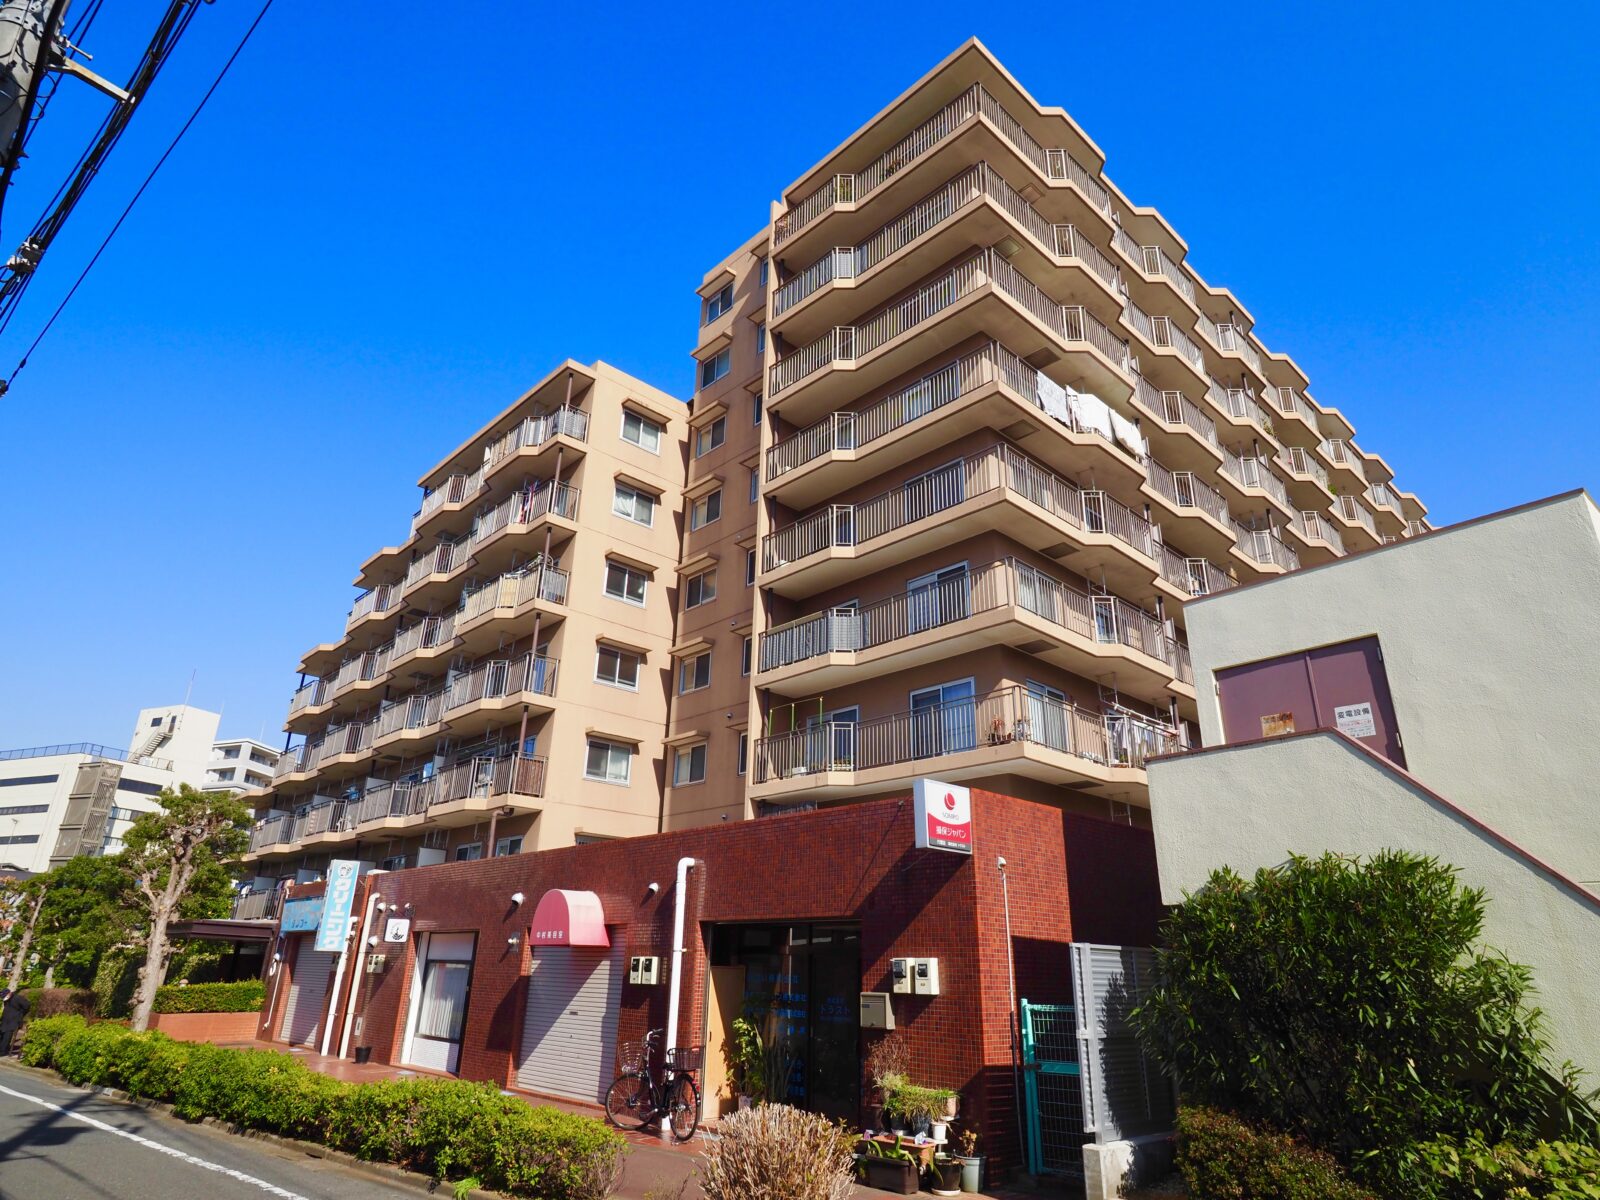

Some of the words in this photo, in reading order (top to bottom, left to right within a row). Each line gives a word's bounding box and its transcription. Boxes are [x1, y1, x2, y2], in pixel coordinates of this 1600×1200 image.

[936, 826, 966, 838] 損保ジャパン
[323, 880, 351, 949] クリーニング
